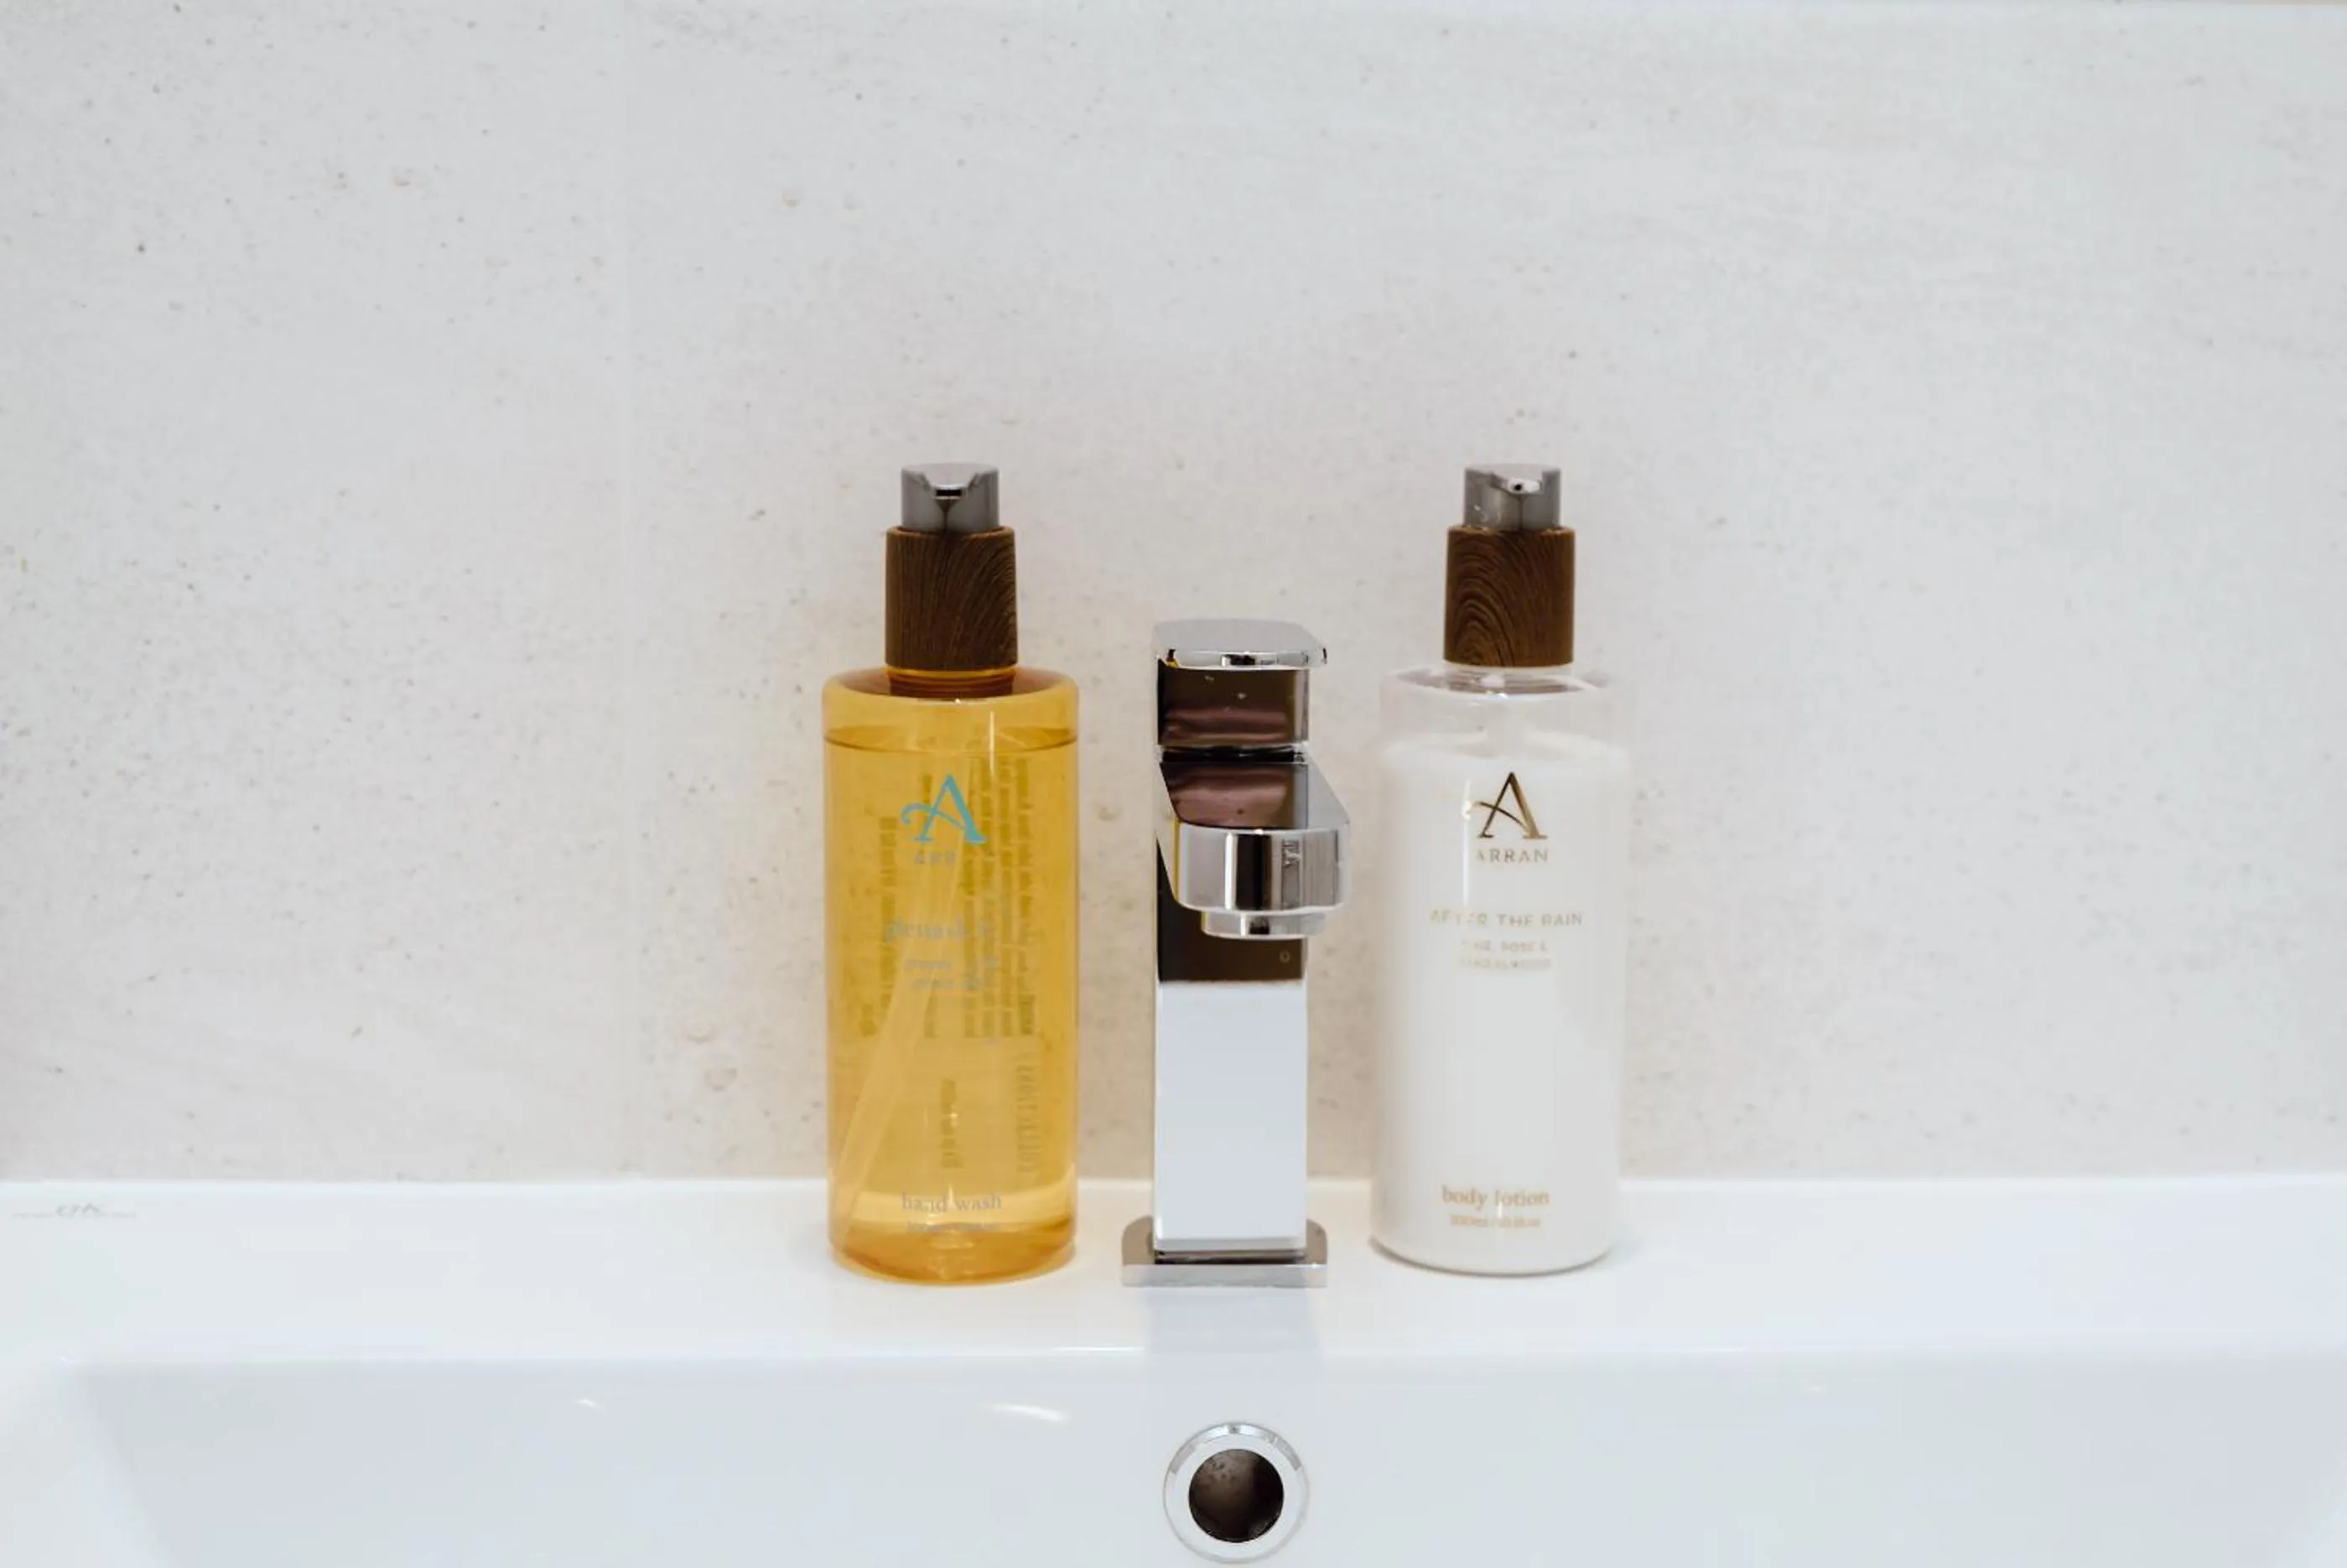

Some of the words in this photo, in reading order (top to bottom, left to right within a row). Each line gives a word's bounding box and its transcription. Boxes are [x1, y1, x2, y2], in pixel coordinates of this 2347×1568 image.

[1476, 847, 1549, 864] ARRAN
[1497, 913, 1534, 927] THE
[1541, 912, 1583, 927] RAIN
[953, 1192, 1003, 1212] wash
[1441, 1183, 1488, 1211] body
[1494, 1189, 1550, 1207] lotion
